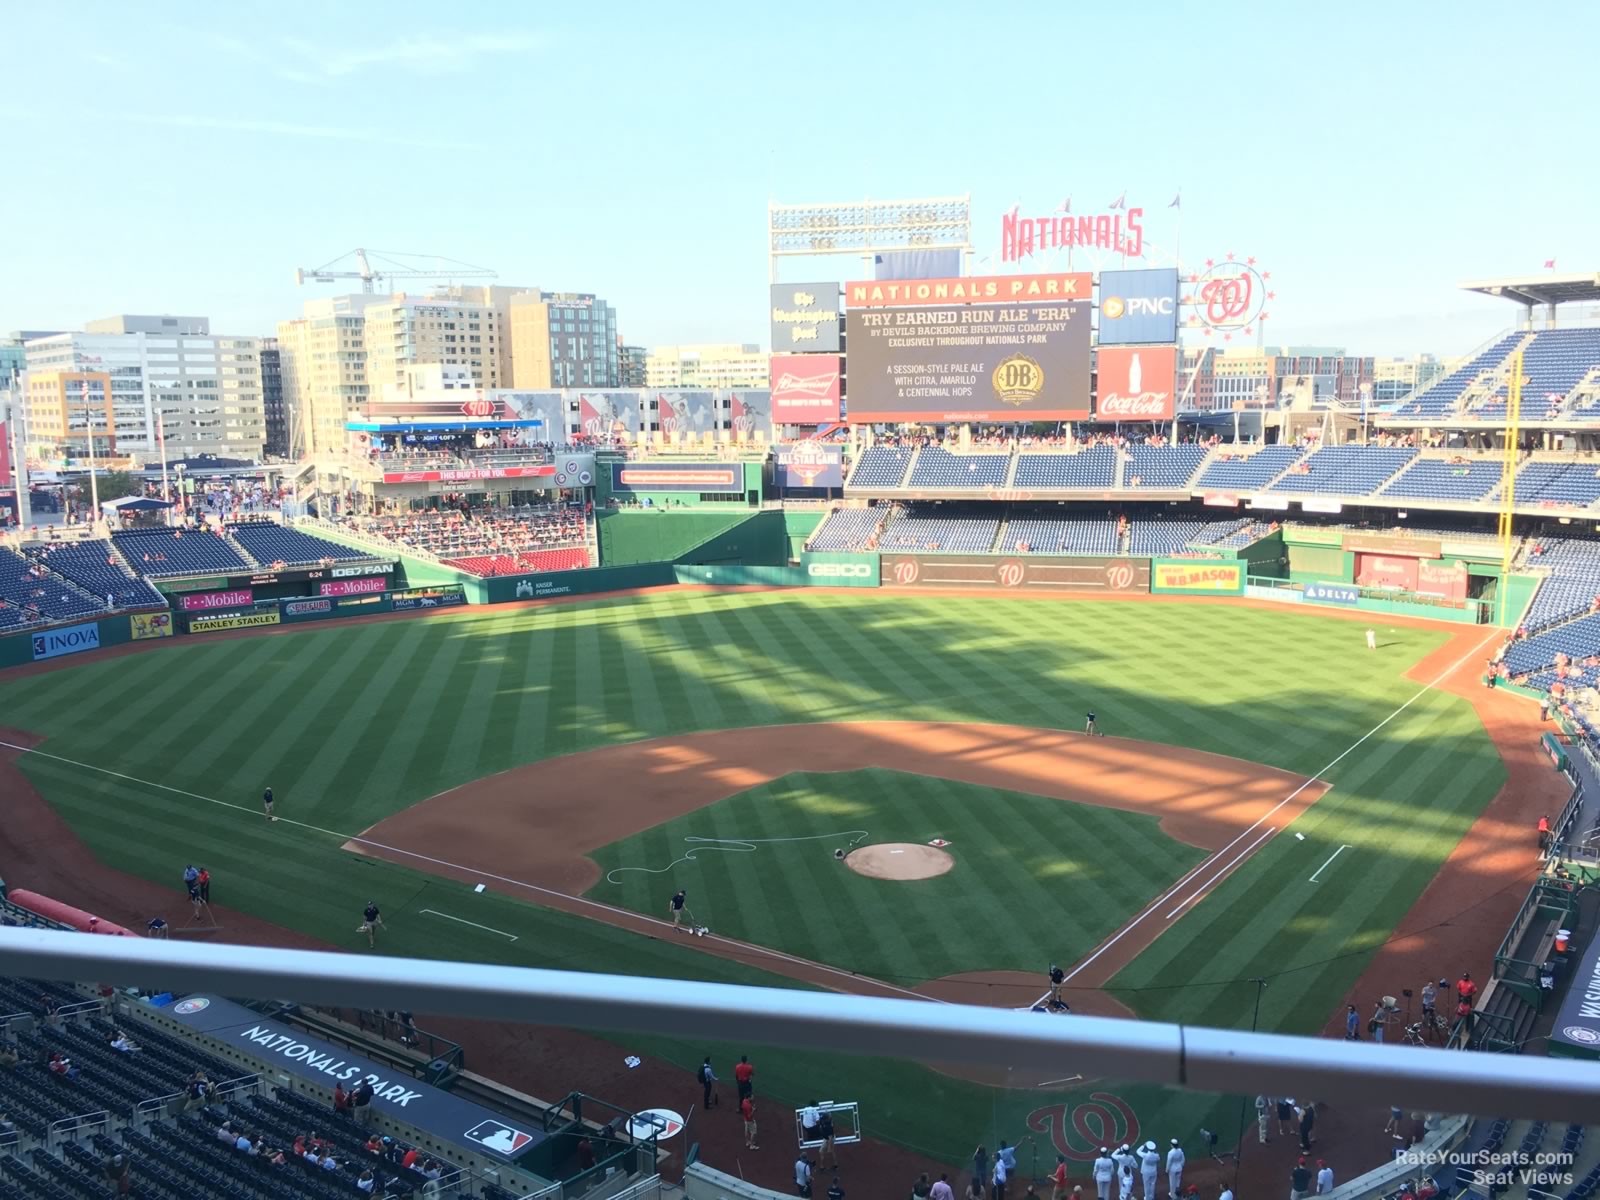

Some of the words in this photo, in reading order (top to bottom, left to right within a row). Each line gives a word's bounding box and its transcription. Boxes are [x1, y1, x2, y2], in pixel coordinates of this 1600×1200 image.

[1002, 207, 1143, 262] NATIONALS
[853, 282, 998, 301] NATIONALS
[1010, 278, 1078, 295] PARK
[1128, 297, 1173, 316] PNC
[861, 313, 892, 326] TRY
[896, 311, 957, 325] EARNED
[961, 309, 994, 323] RUN
[998, 309, 1028, 322] ALE
[1032, 307, 1077, 320] "ERA"
[870, 329, 881, 337] BY
[882, 327, 916, 336] DEVILS
[917, 325, 969, 335] BACKBONE
[970, 324, 1016, 334] BREWING
[1017, 322, 1067, 332] COMPANY
[888, 338, 935, 347] EXCLUSIVELY
[936, 336, 984, 345] THROUGHOUT
[985, 335, 1026, 344] NATIONALS
[1027, 334, 1047, 343] PARK
[886, 365, 893, 375] A
[894, 363, 949, 374] SESSION-STYLE
[950, 363, 969, 373] PALE
[970, 362, 985, 373] ALE
[894, 377, 913, 386] WITH
[914, 376, 938, 386] CITRA,
[939, 375, 977, 385] AMARILLO
[1006, 364, 1032, 388] DB
[898, 388, 905, 397] &
[905, 387, 950, 397] CENTENNIAL
[952, 386, 973, 397] HOPS
[440, 472, 456, 480] THIS
[457, 470, 476, 479] BUD'S
[478, 470, 491, 478] FOR
[365, 564, 394, 574] FAN
[808, 563, 871, 577] GEICO
[536, 581, 553, 589] KAISER
[1318, 588, 1355, 600] DELTA
[192, 620, 234, 631] STANLEY
[236, 615, 276, 626] STANLEY
[50, 631, 97, 650] INOVA
[240, 1025, 361, 1080] NATIONALS
[353, 1074, 423, 1107] PARK
